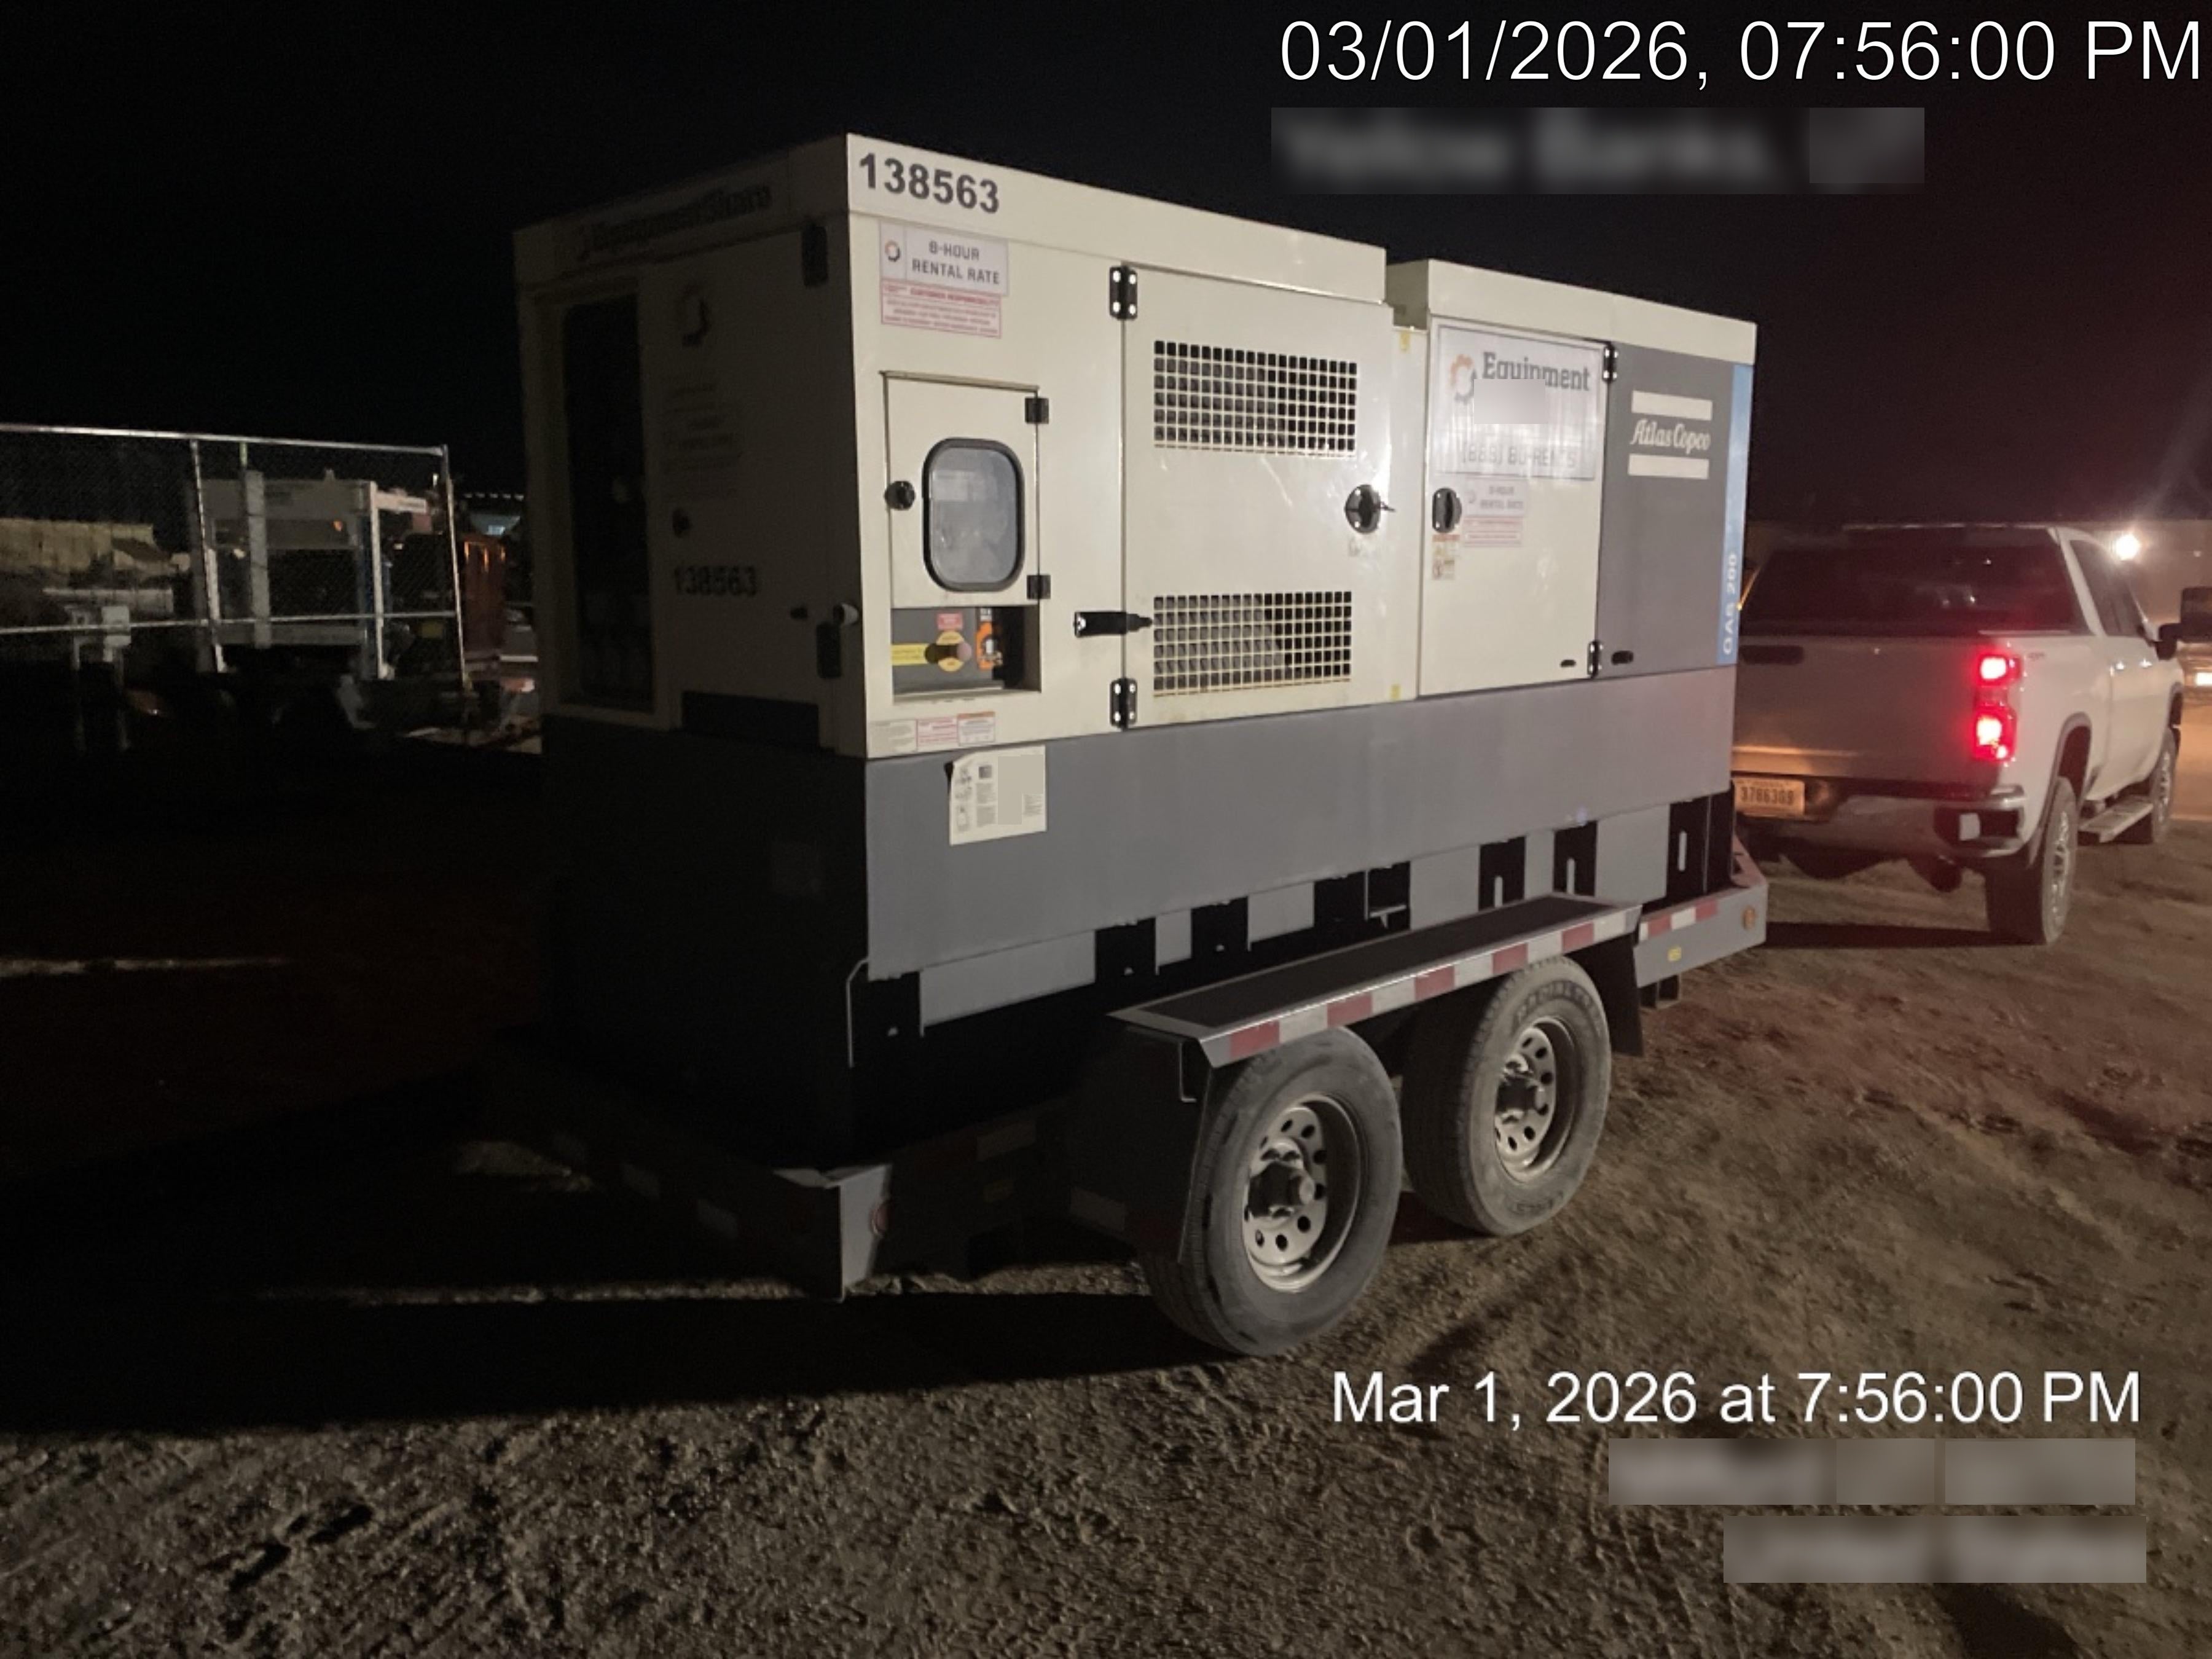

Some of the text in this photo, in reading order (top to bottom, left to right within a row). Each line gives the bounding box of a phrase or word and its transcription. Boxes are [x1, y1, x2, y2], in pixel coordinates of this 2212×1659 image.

[859, 152, 1000, 213] 138563
[929, 240, 979, 261] 8-HOUR
[912, 257, 1000, 284] RENTAL RATE
[1629, 418, 1671, 447] Atlas
[674, 565, 758, 596] 138563
